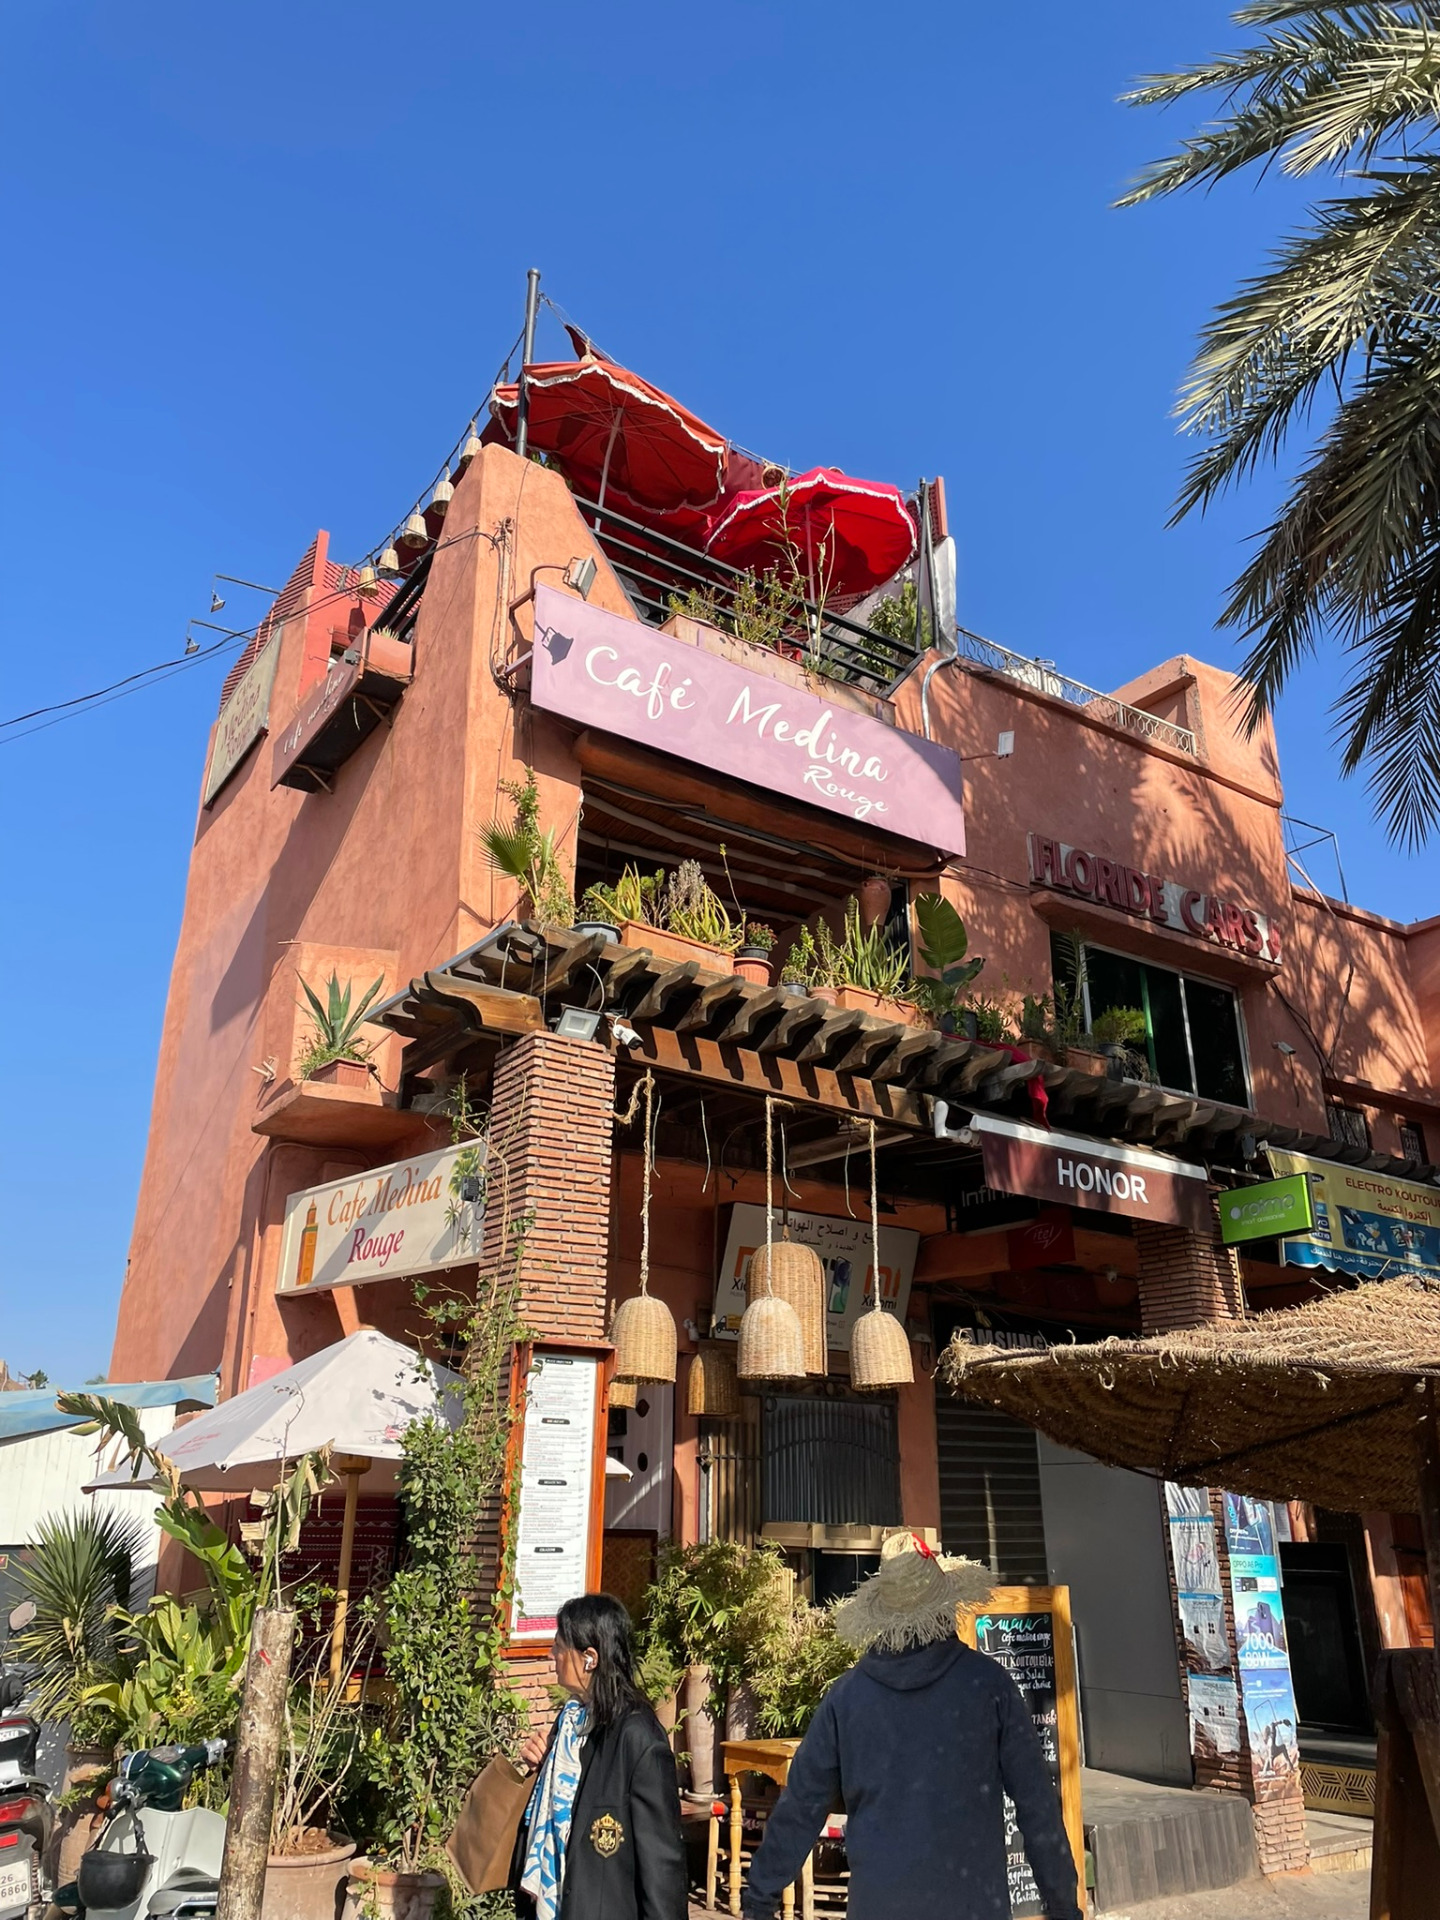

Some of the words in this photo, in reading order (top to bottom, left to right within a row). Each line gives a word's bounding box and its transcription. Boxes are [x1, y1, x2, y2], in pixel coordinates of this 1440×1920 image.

[584, 645, 695, 720] Café
[725, 685, 889, 783] Medina
[803, 765, 889, 820] Rouge
[1030, 832, 1169, 924] FLORIDE
[1180, 890, 1264, 956] CARS
[327, 1179, 367, 1233] Cafe
[367, 1166, 443, 1216] Medina
[961, 1184, 1017, 1208] Infini
[1057, 1157, 1150, 1204] HONOR
[1345, 1176, 1393, 1197] ELECTRO
[347, 1226, 405, 1268] Rouge
[1242, 1632, 1275, 1651] 7000
[1, 1874, 14, 1885] 26
[1, 1882, 28, 1899] 6860
